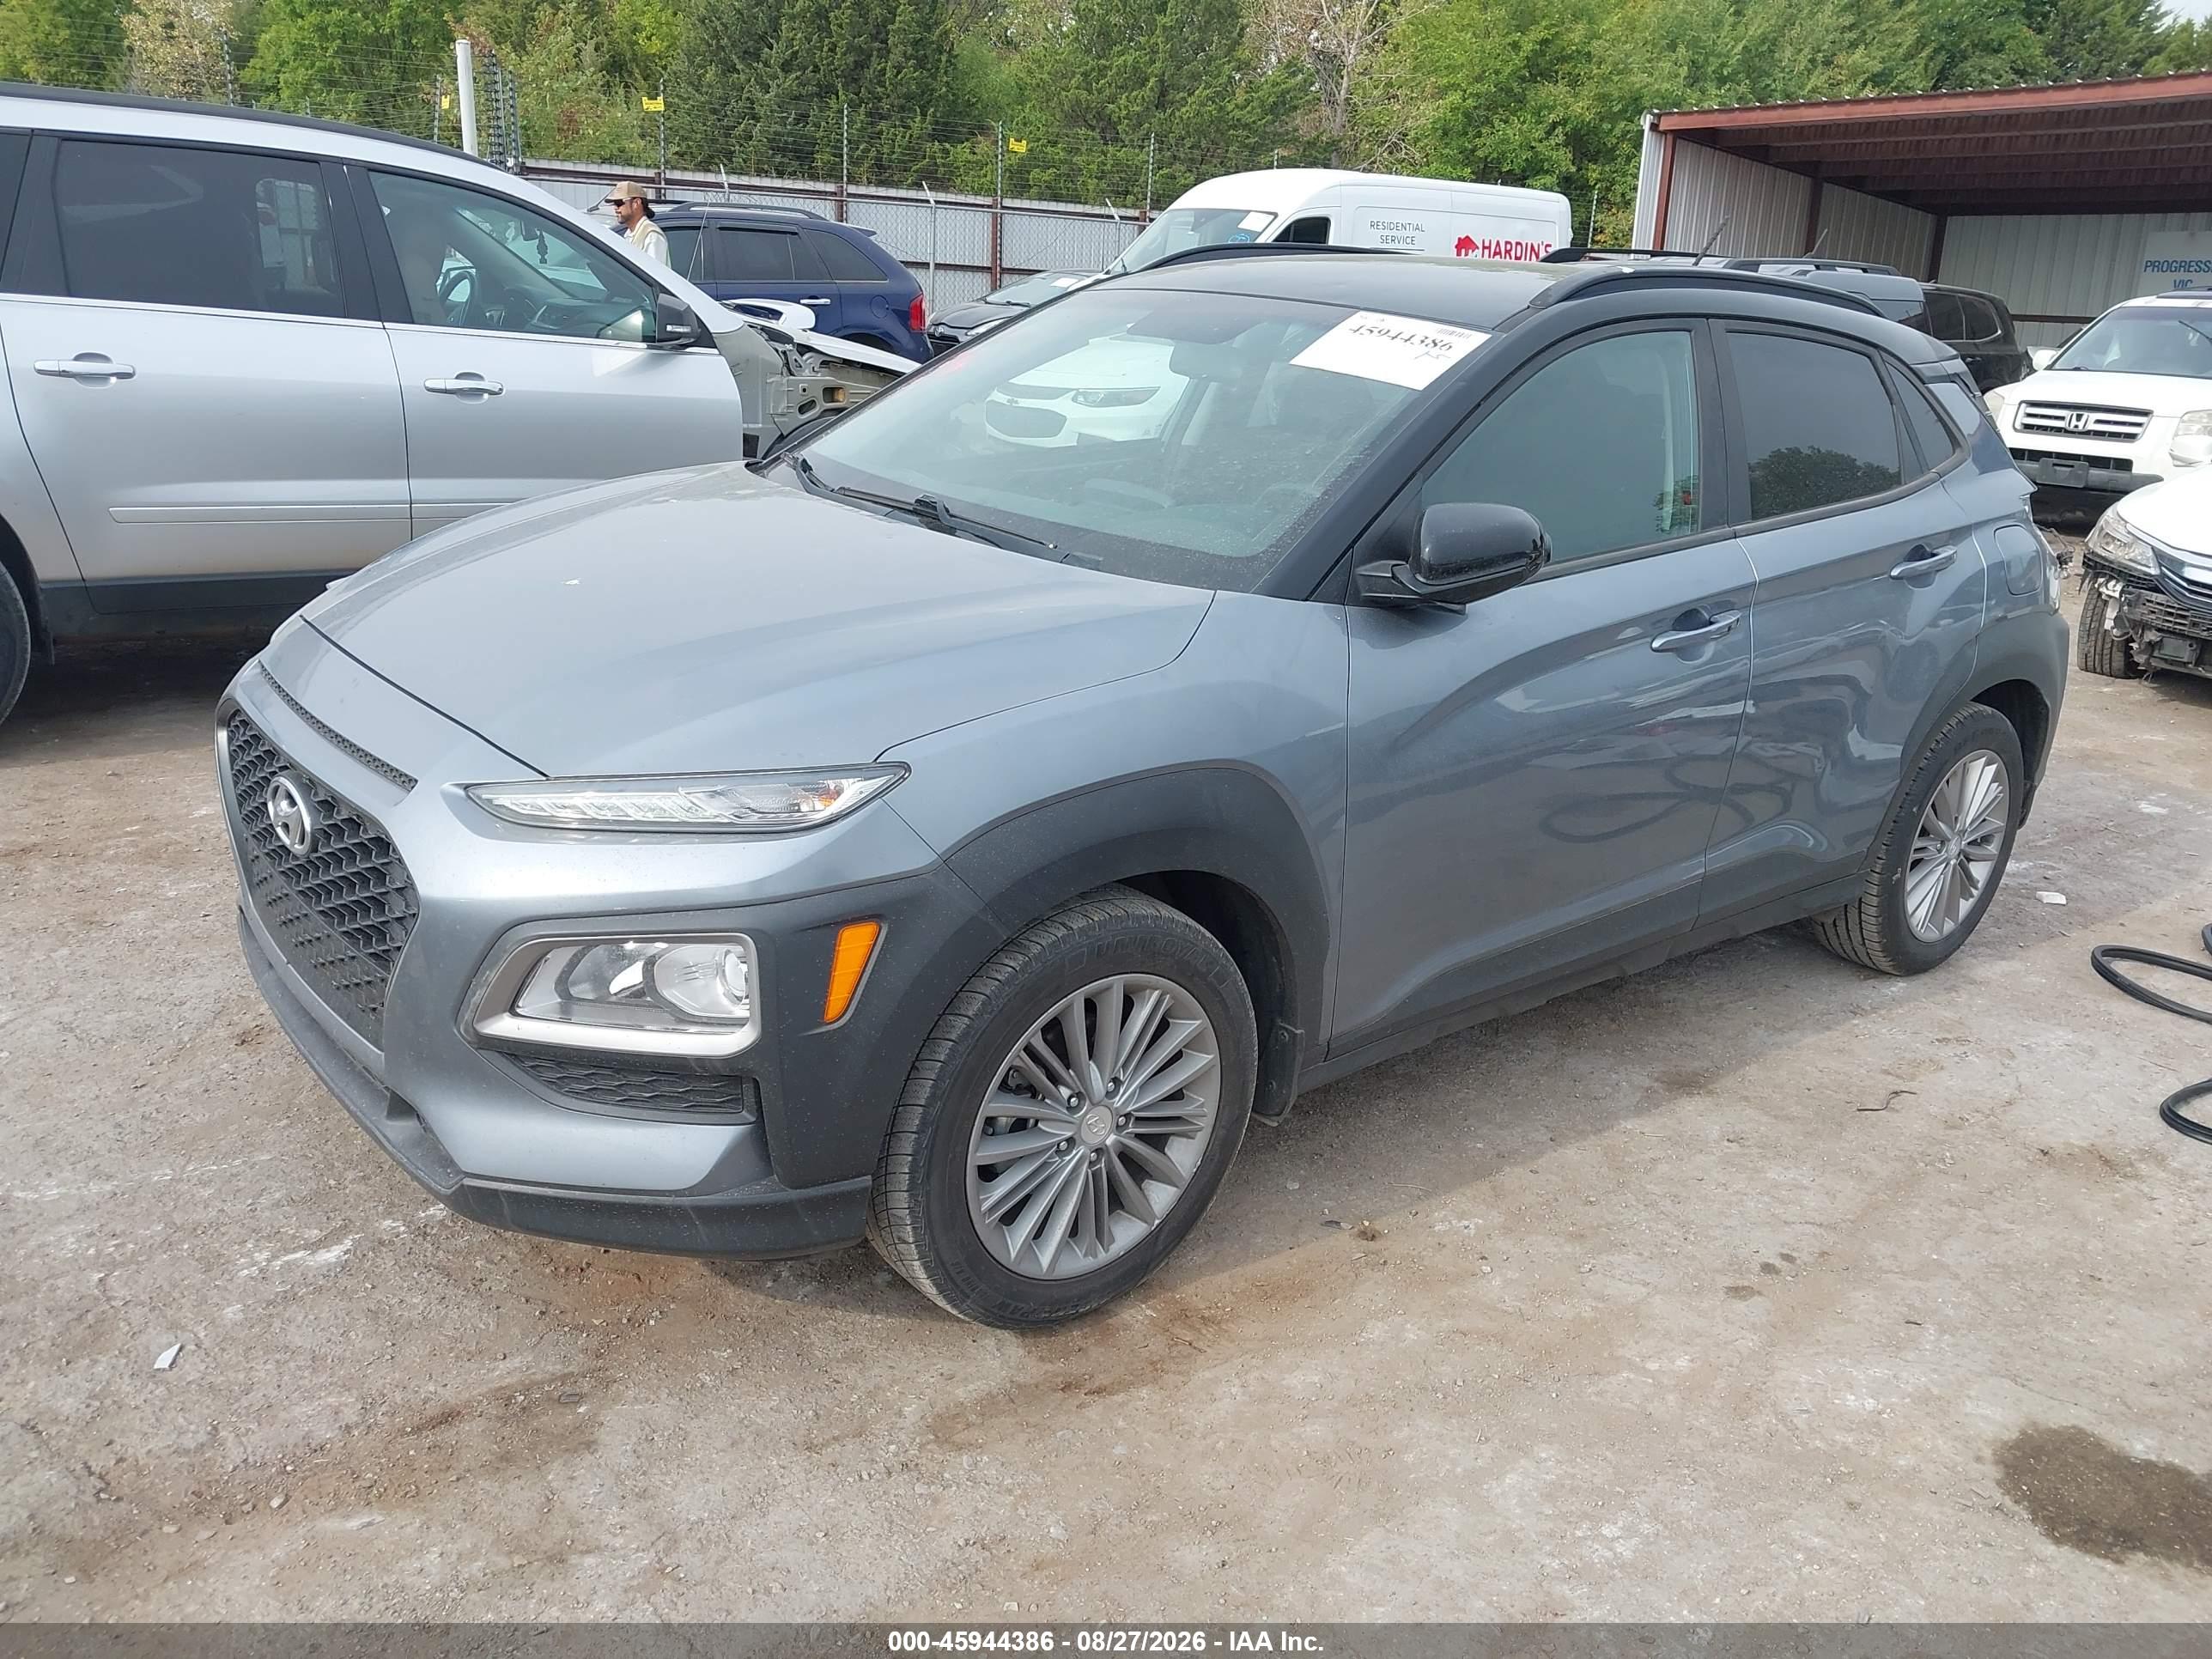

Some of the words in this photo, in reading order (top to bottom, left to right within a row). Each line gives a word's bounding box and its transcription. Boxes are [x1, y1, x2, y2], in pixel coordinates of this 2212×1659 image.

[1370, 221, 1425, 233] RESIDENTIAL
[1379, 234, 1416, 246] SERVICE
[1481, 239, 1553, 262] HARDIN'S
[2143, 259, 2212, 273] PROGRESS
[1349, 324, 1454, 352] 45944386
